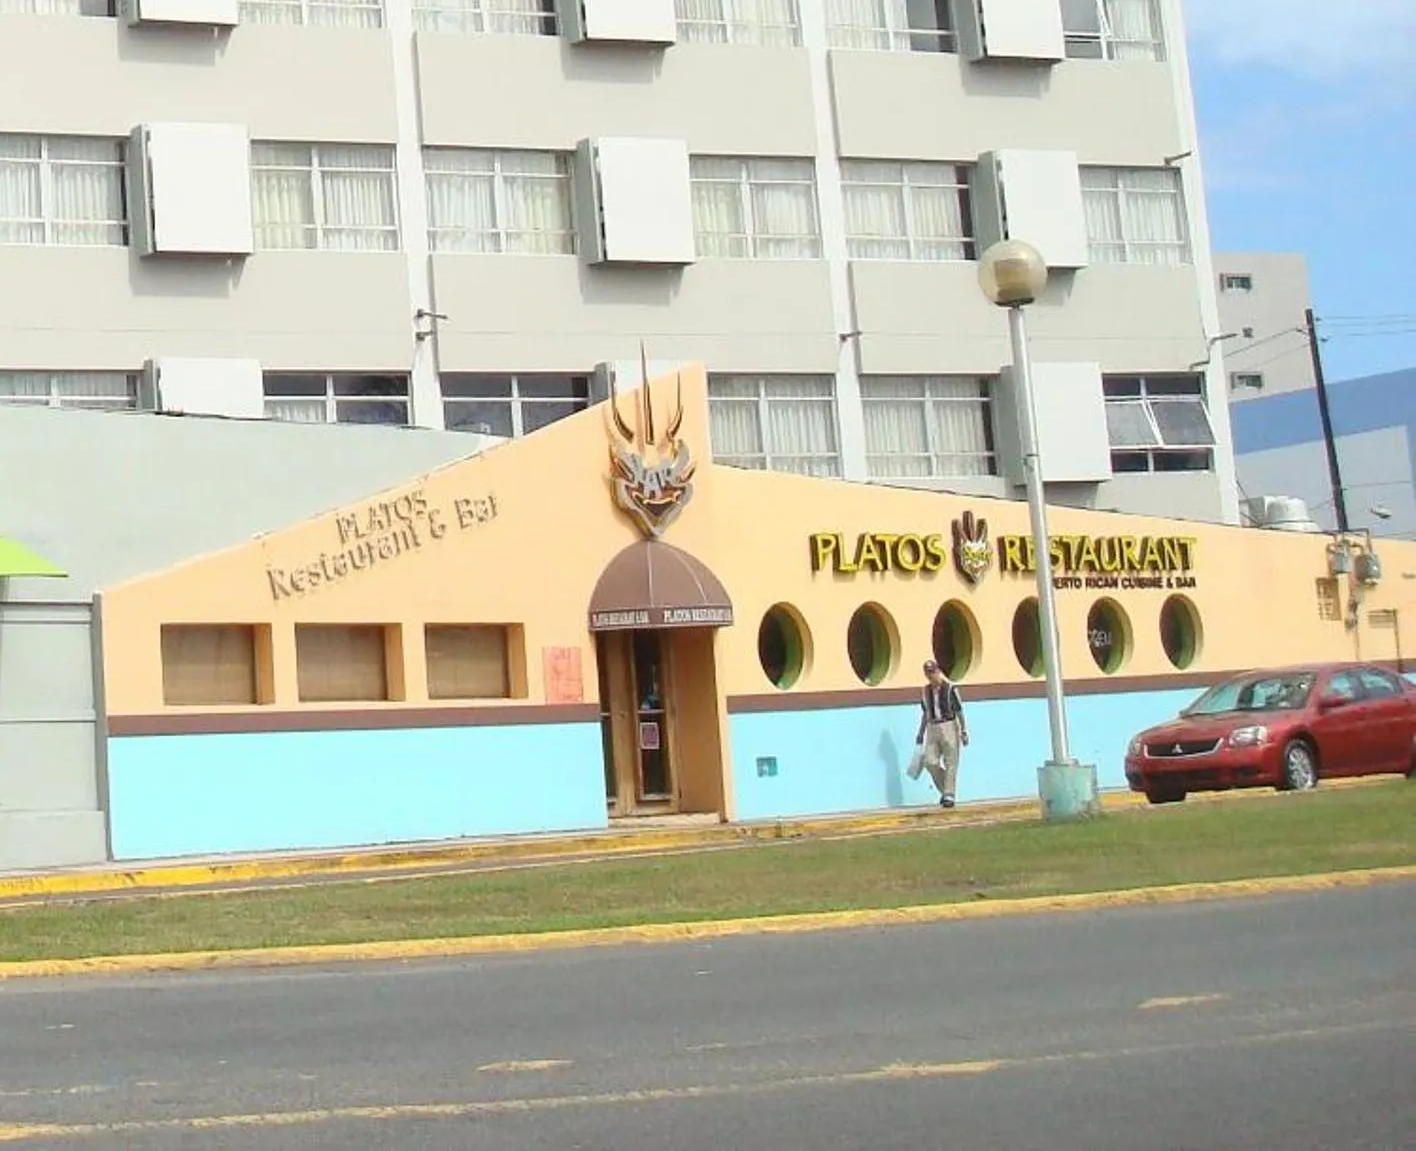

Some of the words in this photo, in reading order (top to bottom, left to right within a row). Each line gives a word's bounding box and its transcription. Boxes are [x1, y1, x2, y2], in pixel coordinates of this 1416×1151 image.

[335, 490, 429, 545] PLATOS
[266, 519, 422, 601] Restaurant
[428, 509, 448, 540] &
[454, 496, 499, 529] Bar
[810, 533, 946, 571] PLATOS
[1054, 577, 1083, 589] ERTO
[1085, 577, 1118, 589] RICAN
